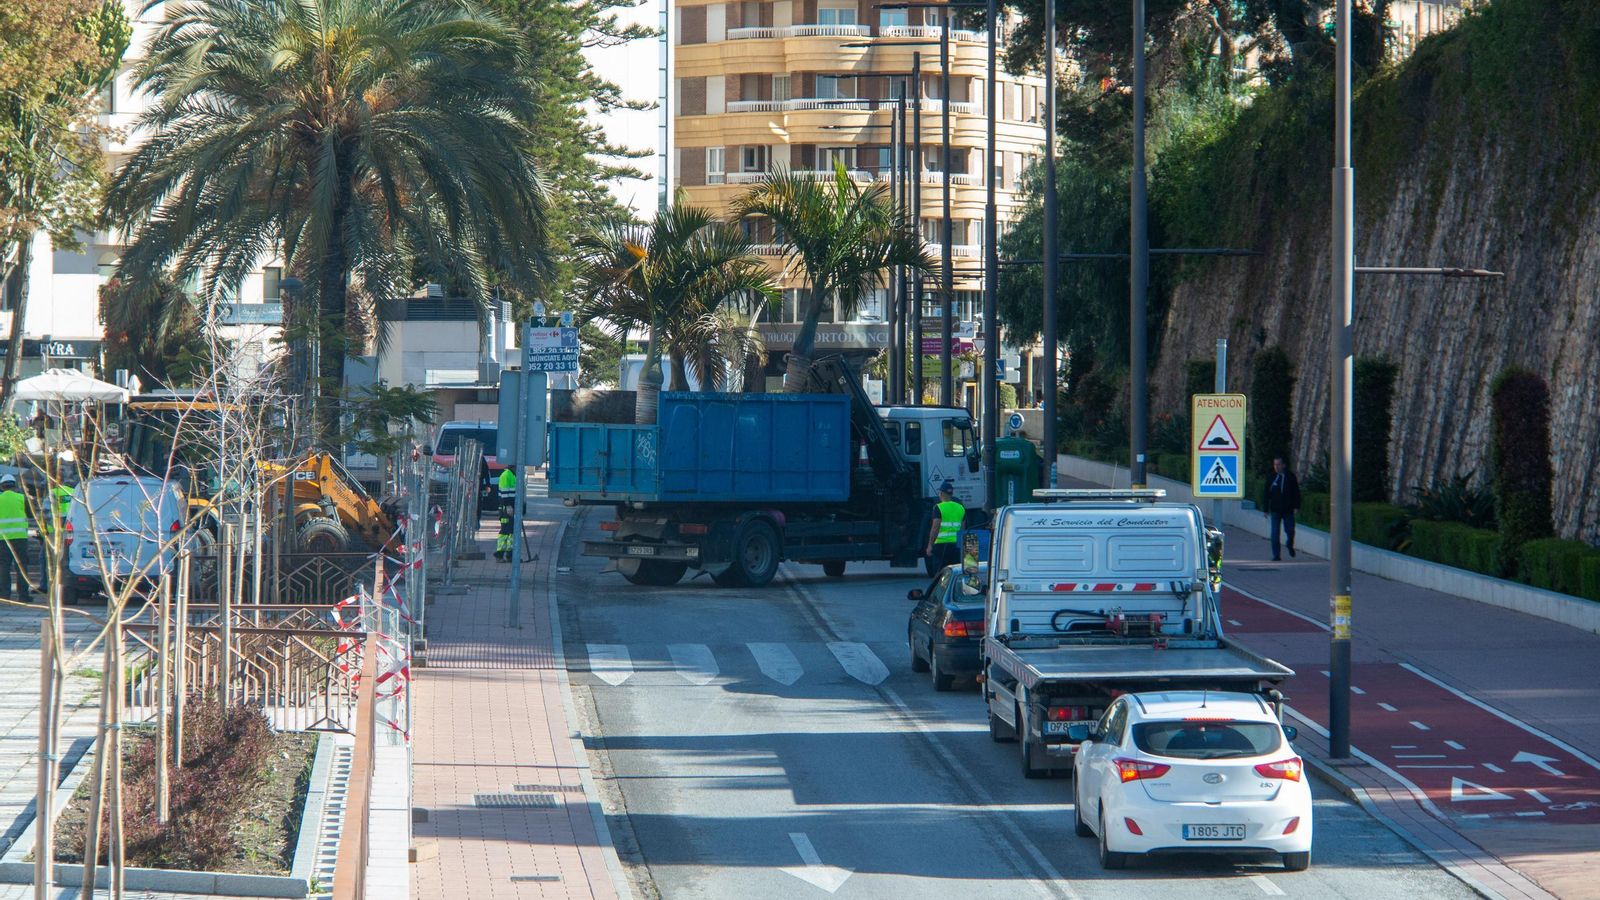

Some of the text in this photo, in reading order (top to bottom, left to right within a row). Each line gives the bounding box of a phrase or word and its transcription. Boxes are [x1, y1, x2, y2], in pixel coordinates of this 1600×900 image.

[543, 362, 554, 370] 20
[555, 362, 566, 370] 33
[567, 361, 577, 369] 10
[1197, 398, 1243, 408] ATENCIÓN
[1051, 518, 1093, 526] Servicio
[1097, 518, 1113, 526] del
[1192, 827, 1244, 837] 1805 JTC
